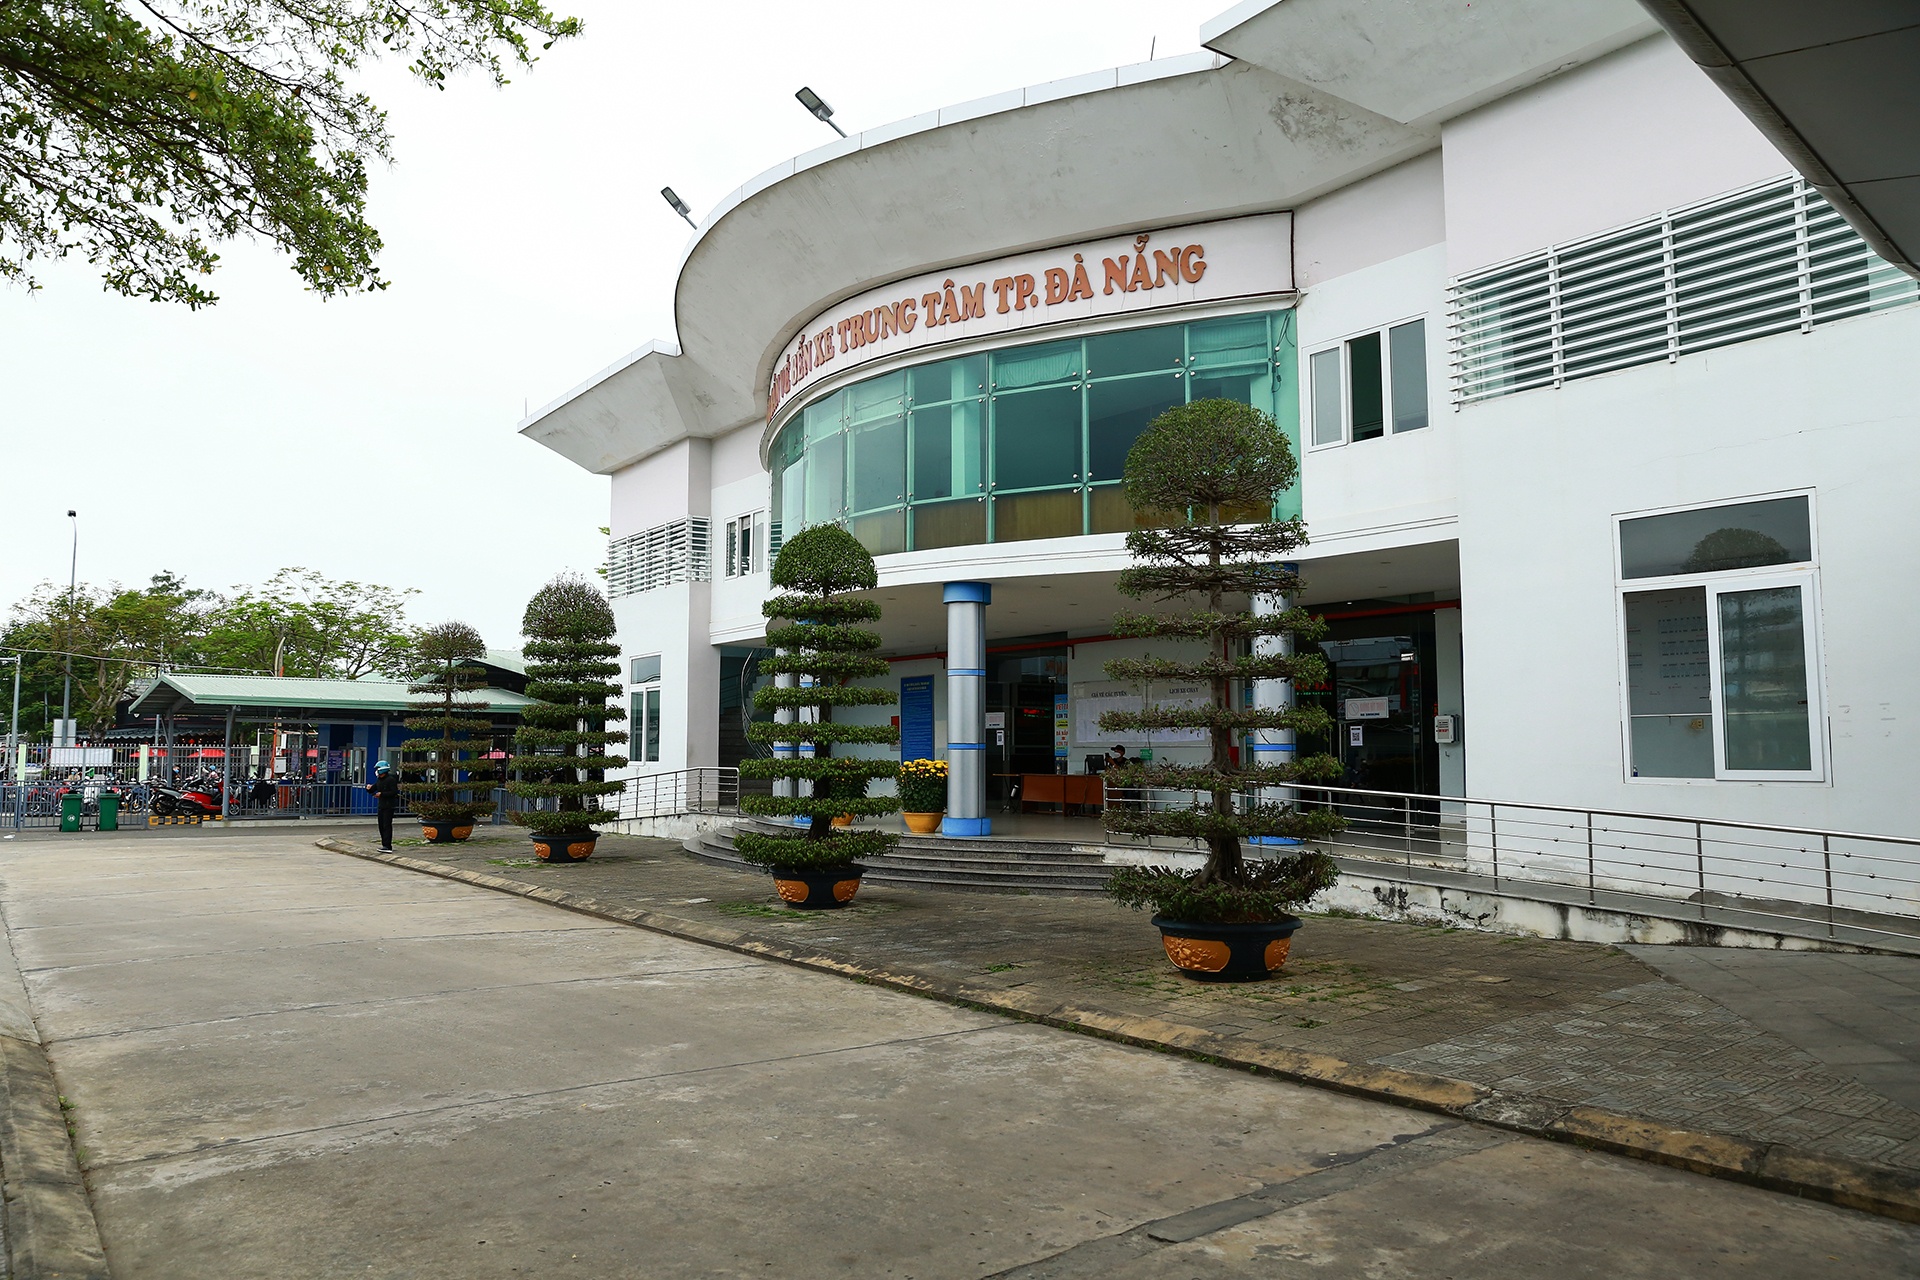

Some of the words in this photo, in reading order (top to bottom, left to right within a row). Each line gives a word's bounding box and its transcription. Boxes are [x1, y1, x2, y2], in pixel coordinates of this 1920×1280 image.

[791, 334, 813, 387] BẾN
[813, 325, 835, 368] XE
[837, 298, 918, 354] TRUNG
[921, 278, 986, 328] TÂM
[993, 273, 1039, 314] TP.
[1044, 253, 1094, 306] ĐÀ
[1102, 234, 1207, 296] NẴNG
